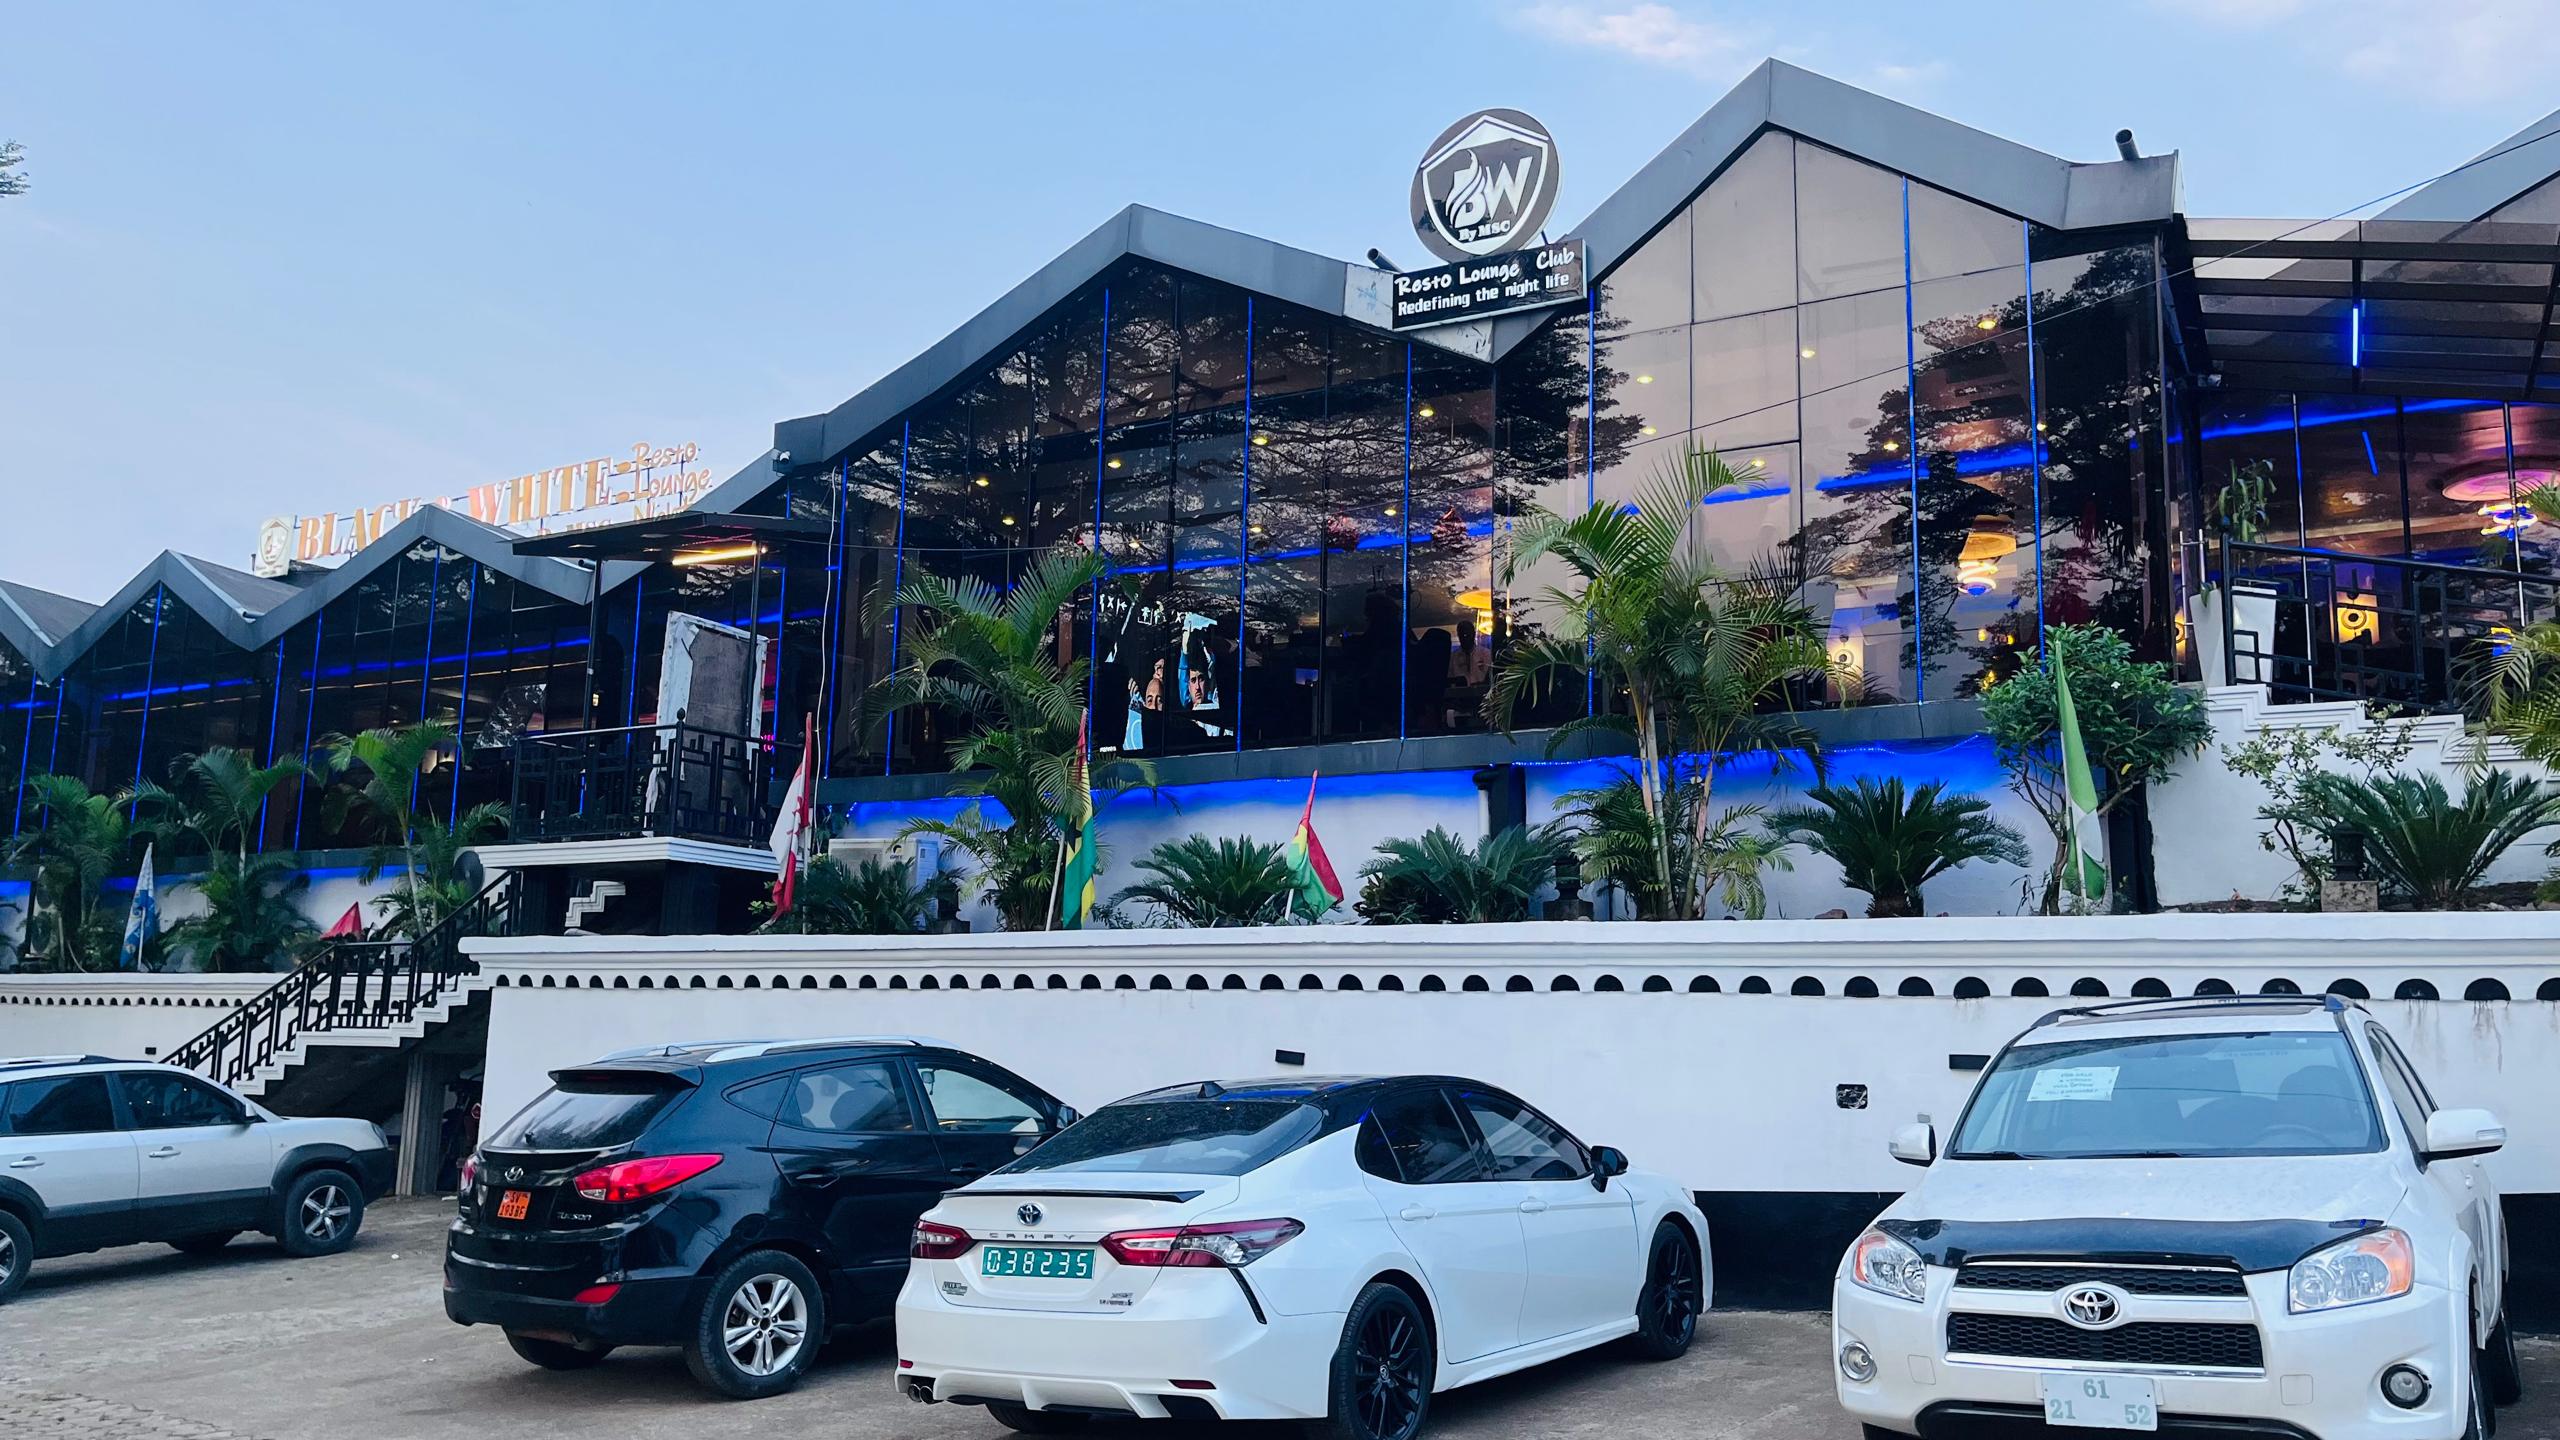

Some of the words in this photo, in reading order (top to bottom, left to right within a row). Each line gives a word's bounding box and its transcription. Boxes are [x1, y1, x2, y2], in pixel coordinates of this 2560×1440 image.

[1458, 228, 1477, 242] By
[1478, 219, 1511, 238] MSC
[1394, 273, 1452, 297] Resto
[1459, 262, 1520, 285] Lounge
[1536, 247, 1575, 270] Club
[1397, 292, 1471, 317] Redefining
[1475, 286, 1499, 302] the
[1505, 278, 1540, 298] night
[1545, 273, 1569, 290] life
[632, 442, 698, 468] Resto
[466, 456, 613, 527] WHITE
[634, 468, 712, 503] Lounge
[2083, 1378, 2110, 1399] 61
[2050, 1399, 2076, 1420] 21
[2124, 1404, 2151, 1425] 52
